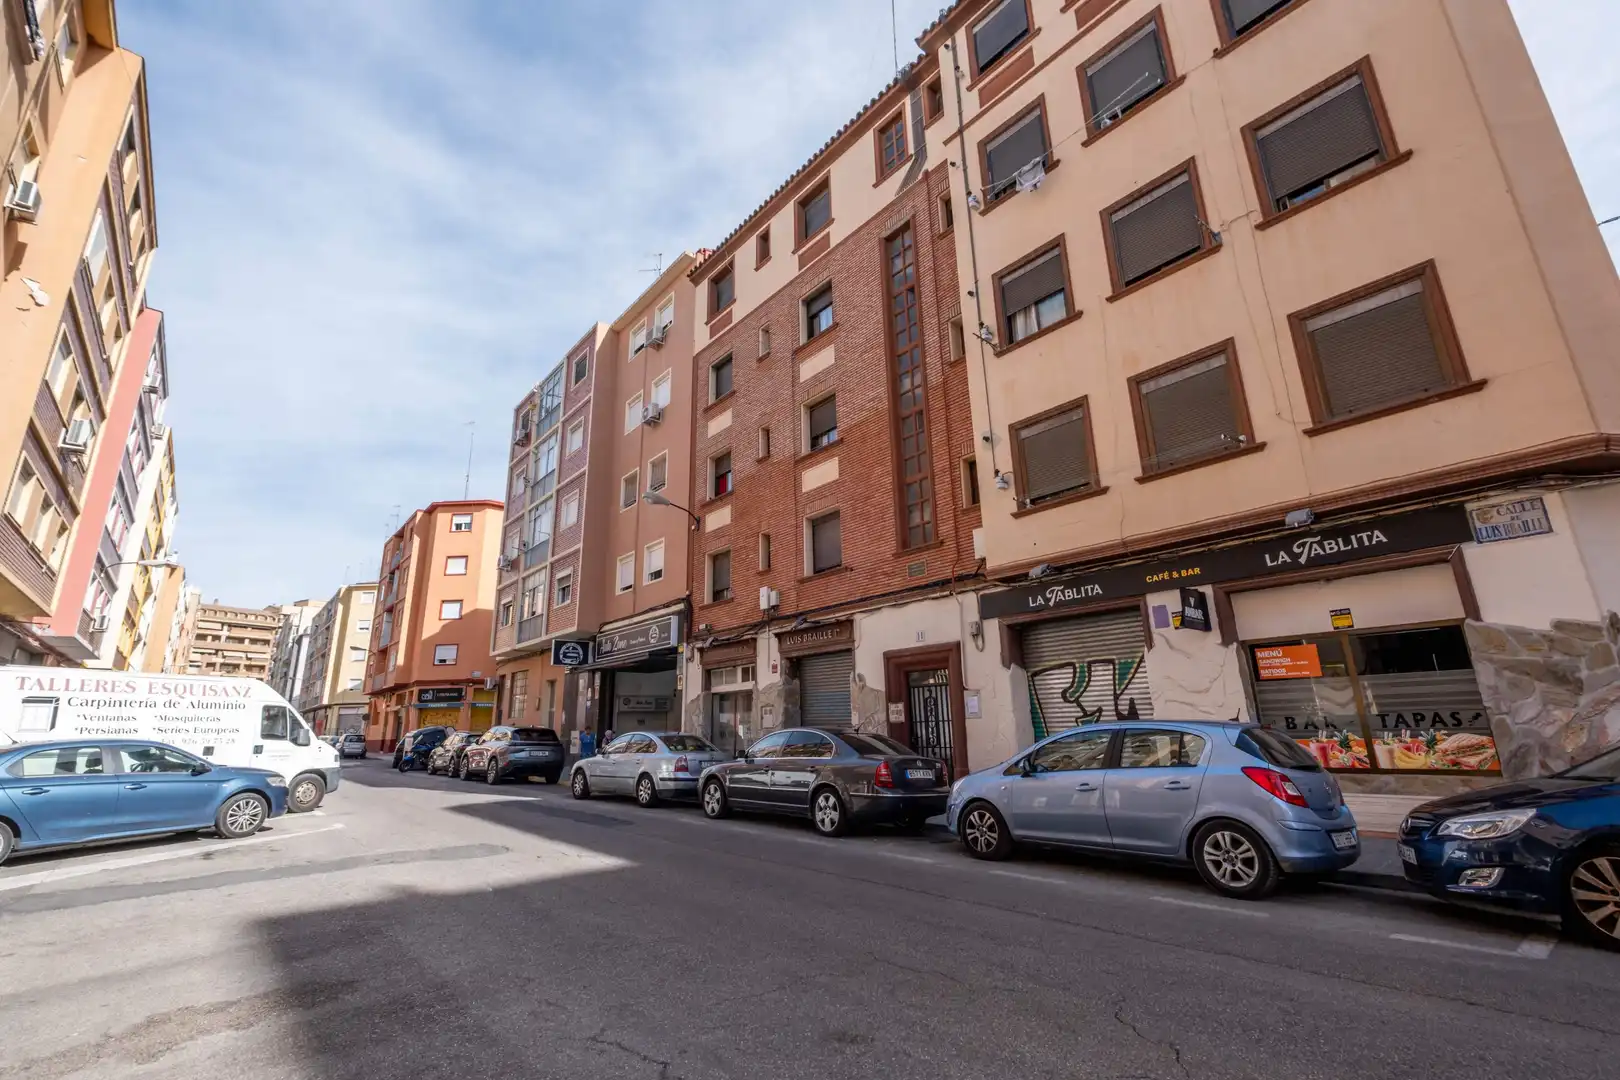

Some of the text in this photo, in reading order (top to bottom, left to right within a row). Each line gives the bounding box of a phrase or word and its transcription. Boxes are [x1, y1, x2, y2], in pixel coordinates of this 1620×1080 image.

[1496, 500, 1540, 516] CALLE
[1264, 550, 1292, 567] LA
[1146, 572, 1169, 583] CAFÉ
[1181, 567, 1201, 577] BAR
[1029, 594, 1045, 607] LA
[786, 635, 802, 645] LUIS
[803, 630, 832, 643] BRAILLE
[1257, 649, 1283, 658] MENÚ
[15, 676, 252, 699] TALLERES ESQUISANZ
[67, 696, 246, 710] Carpintería de Aluminio
[1376, 711, 1463, 729] TAPAS
